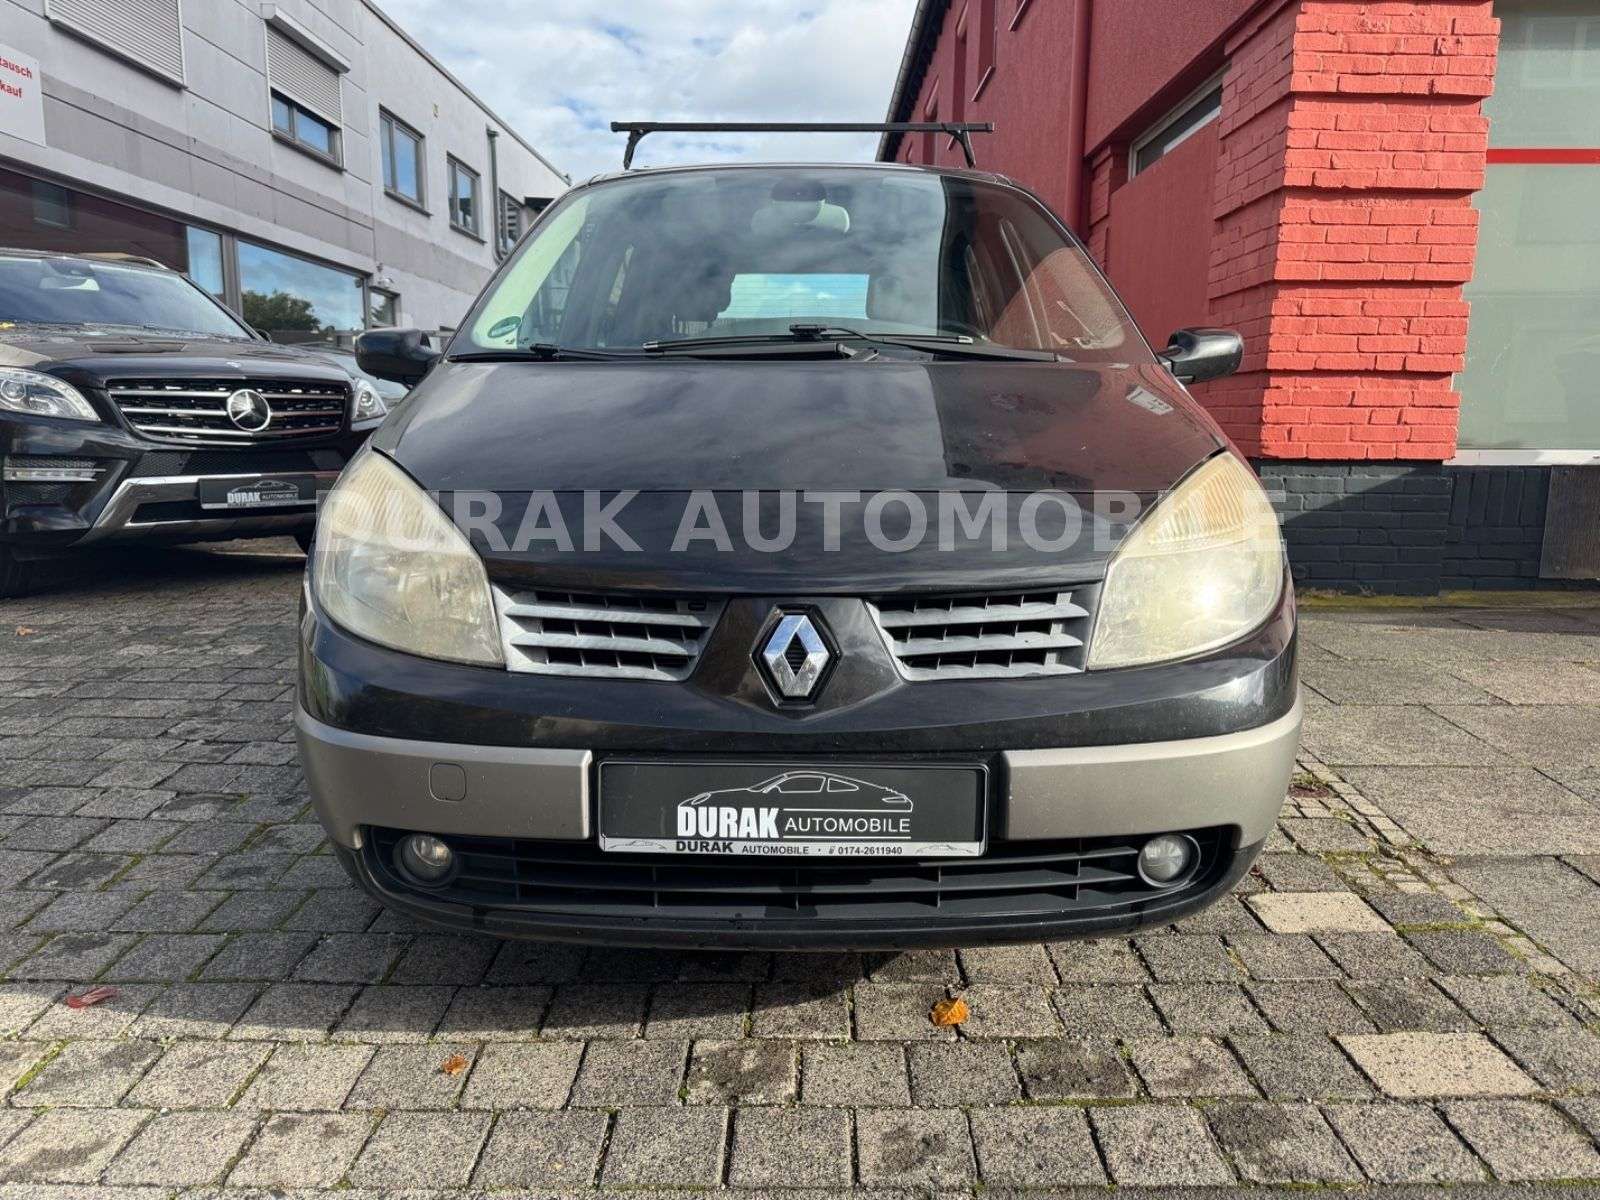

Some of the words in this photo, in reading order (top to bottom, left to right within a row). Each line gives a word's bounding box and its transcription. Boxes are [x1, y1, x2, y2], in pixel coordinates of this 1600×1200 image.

[227, 492, 260, 503] DURAK
[677, 806, 780, 838] DURAK
[784, 817, 911, 832] AUTOMOBILE
[676, 841, 734, 853] DURAK
[742, 845, 809, 854] AUTOMOBILE
[837, 846, 903, 855] 0174-2611940
